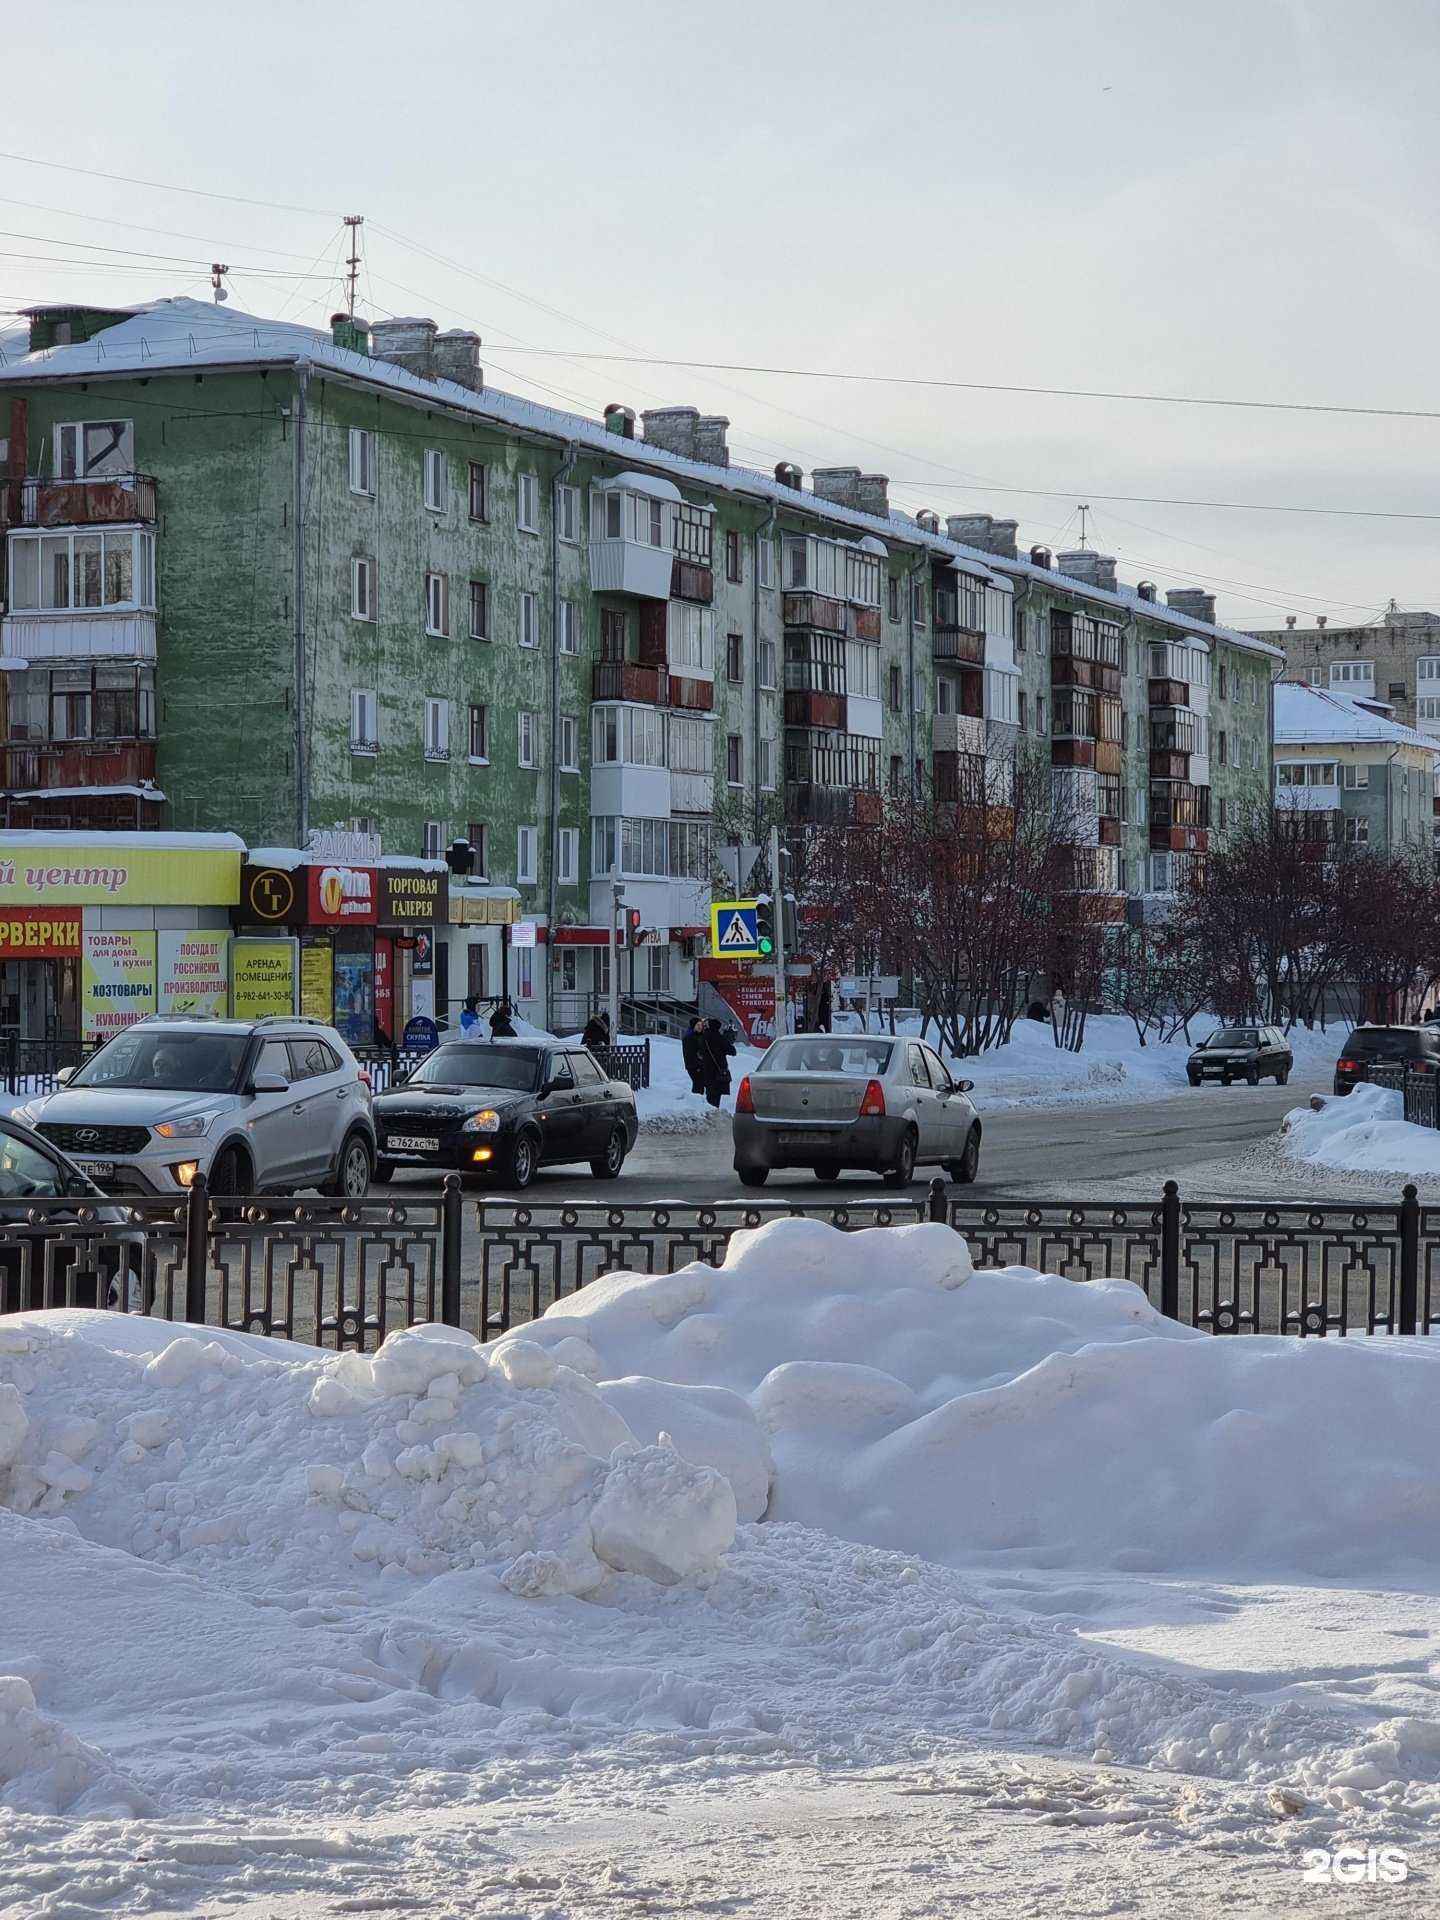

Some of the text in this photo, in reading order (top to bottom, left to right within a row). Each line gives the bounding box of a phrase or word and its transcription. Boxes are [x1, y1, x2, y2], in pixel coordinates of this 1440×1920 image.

[25, 865, 128, 892] центр
[387, 878, 438, 894] ТОРГОВАЯ
[392, 900, 433, 917] ГАЛЕРЕЯ
[87, 935, 132, 946] ТОВАРЫ
[92, 948, 138, 958] для дома
[122, 959, 153, 969] кухни
[245, 959, 282, 969] АРЕНДА
[235, 971, 294, 983] ПОМЕЩЕНИЯ
